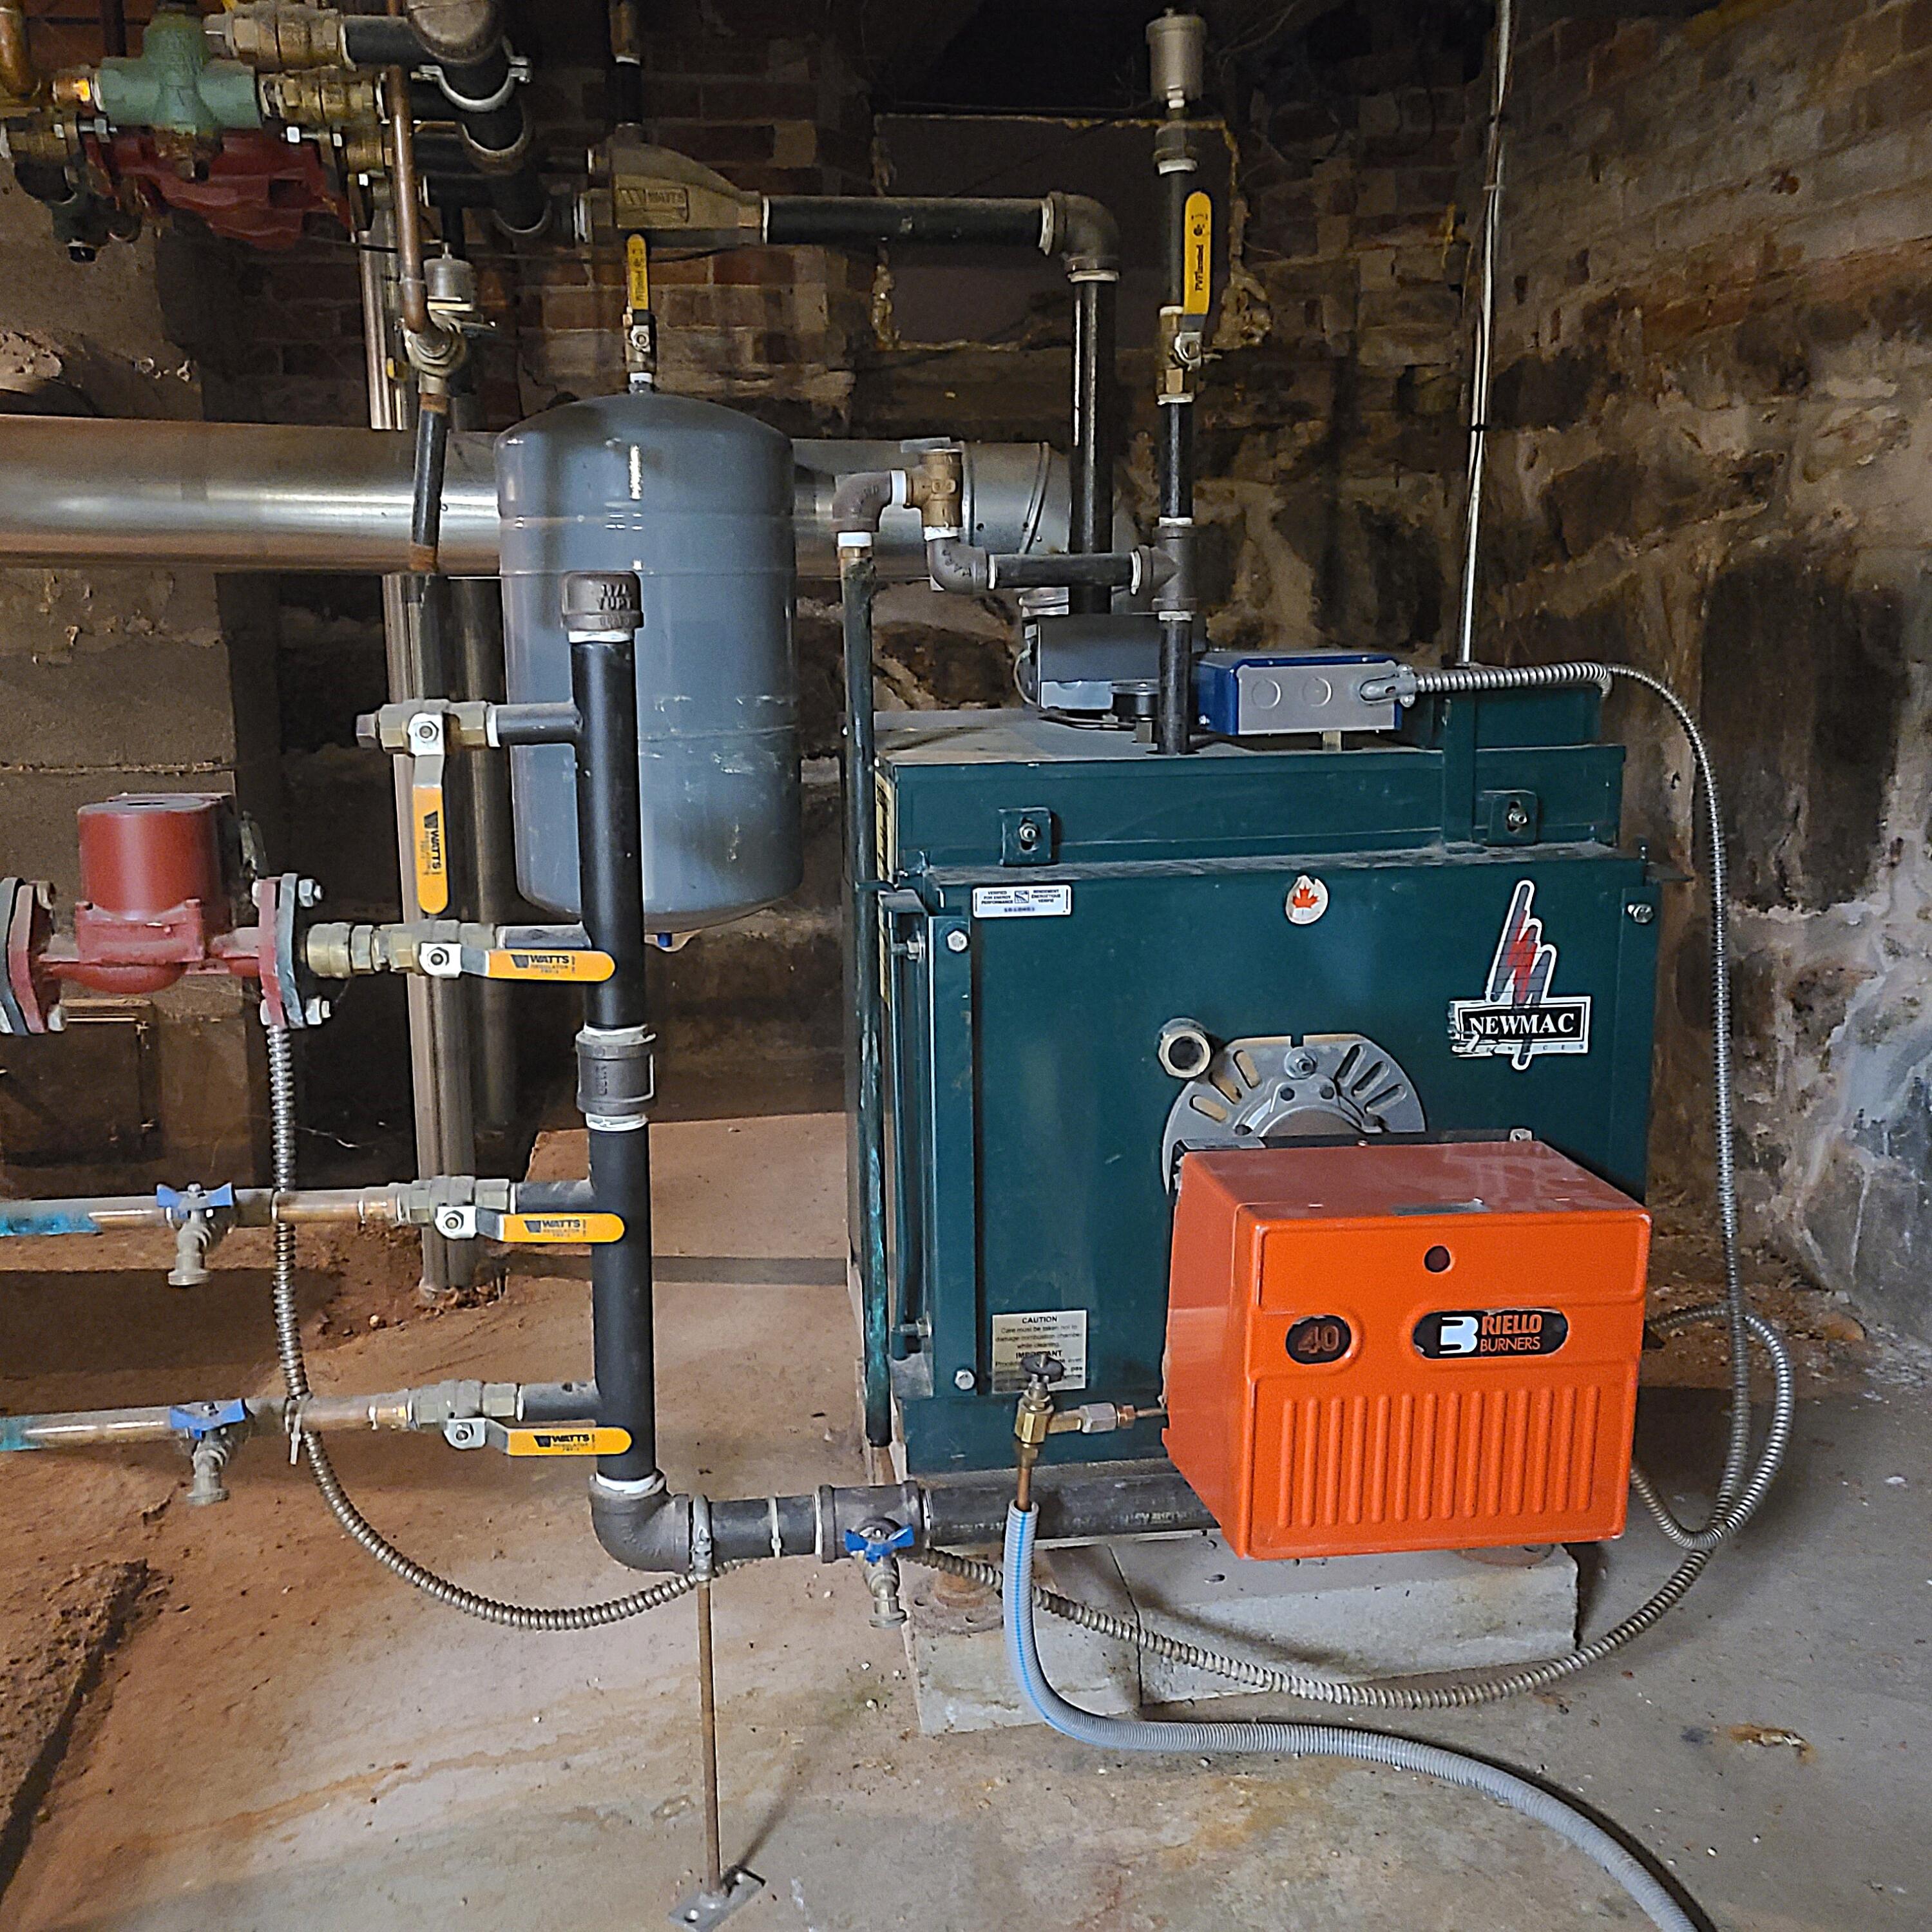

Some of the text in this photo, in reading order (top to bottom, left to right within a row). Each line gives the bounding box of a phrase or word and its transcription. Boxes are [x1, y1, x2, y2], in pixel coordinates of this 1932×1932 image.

[431, 829, 442, 870] WATTS
[530, 955, 569, 964] WATTS
[1469, 1013, 1574, 1035] NEWMAC
[542, 1219, 580, 1228] WATTS
[1481, 1314, 1542, 1335] RIELLO
[1297, 1325, 1341, 1353] 40
[1480, 1337, 1540, 1352] BURNERS
[551, 1434, 589, 1442] WATTS
